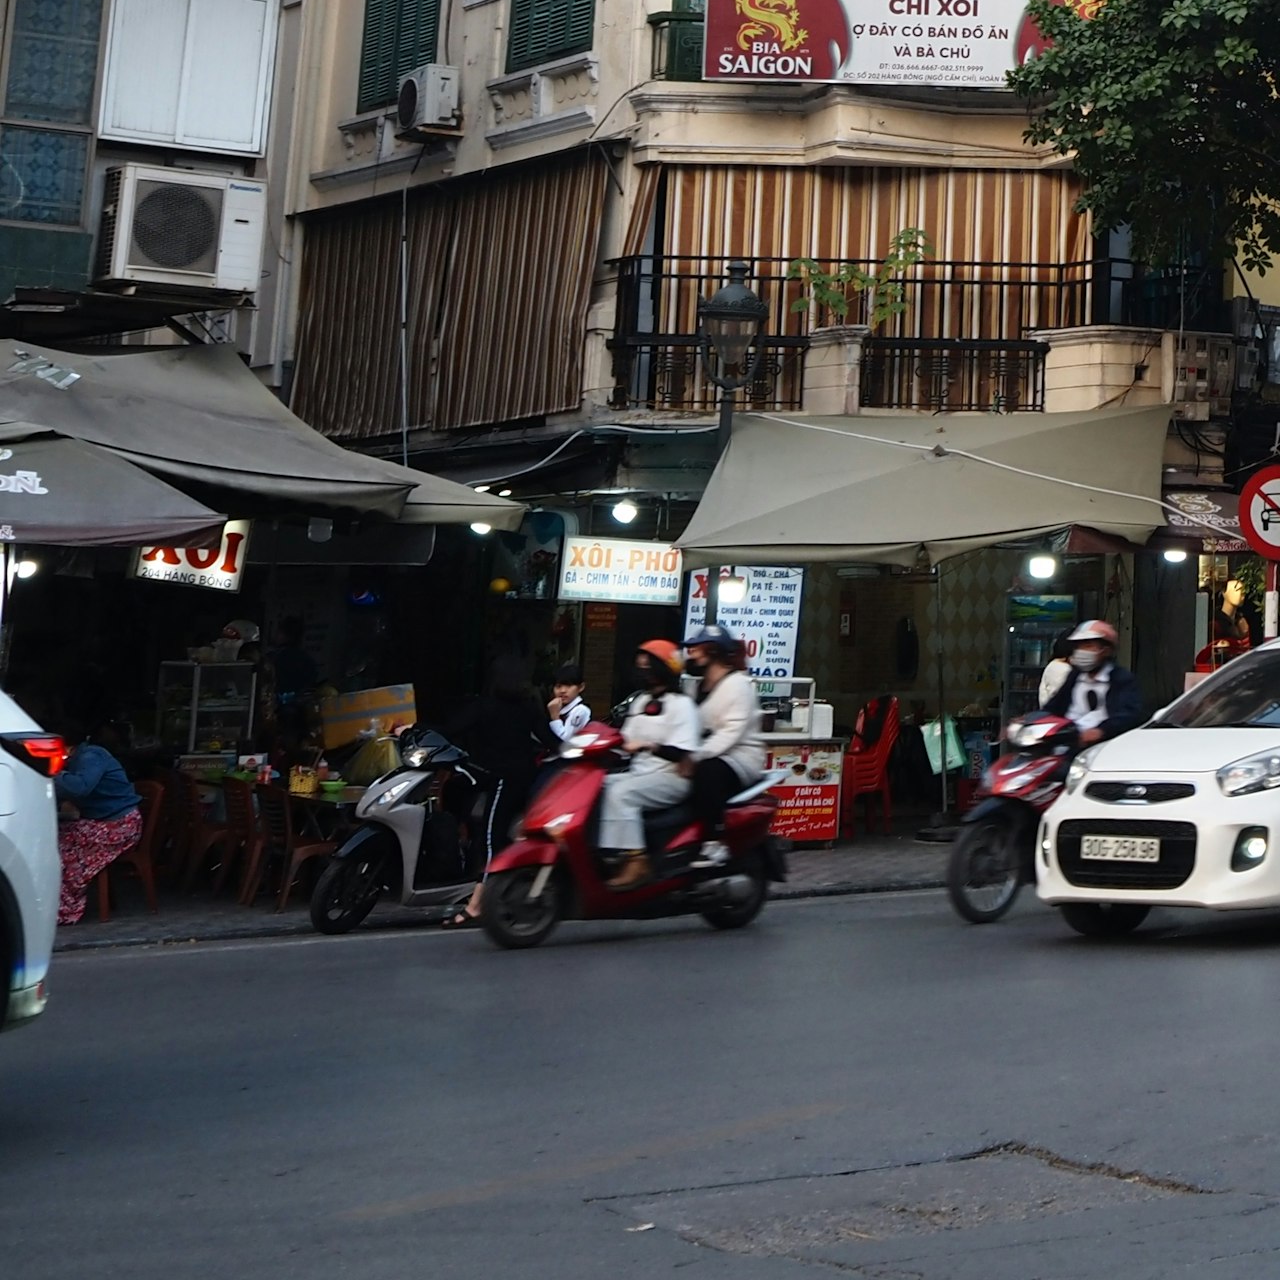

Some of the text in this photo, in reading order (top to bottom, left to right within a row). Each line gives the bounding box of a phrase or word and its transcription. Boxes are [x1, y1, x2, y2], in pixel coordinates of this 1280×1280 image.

[869, 22, 898, 36] ĐÂY
[901, 23, 923, 38] CÓ
[928, 24, 958, 38] BÁN
[987, 25, 1009, 40] ĂN
[752, 41, 781, 55] BIA
[893, 43, 971, 59] VÀ BÀ CHỦ
[718, 53, 812, 76] SAIGON
[230, 183, 262, 192] Panasonic
[569, 543, 612, 569] XÔI
[142, 567, 160, 578] 204
[565, 571, 577, 584] GÀ
[586, 572, 609, 585] CHIM
